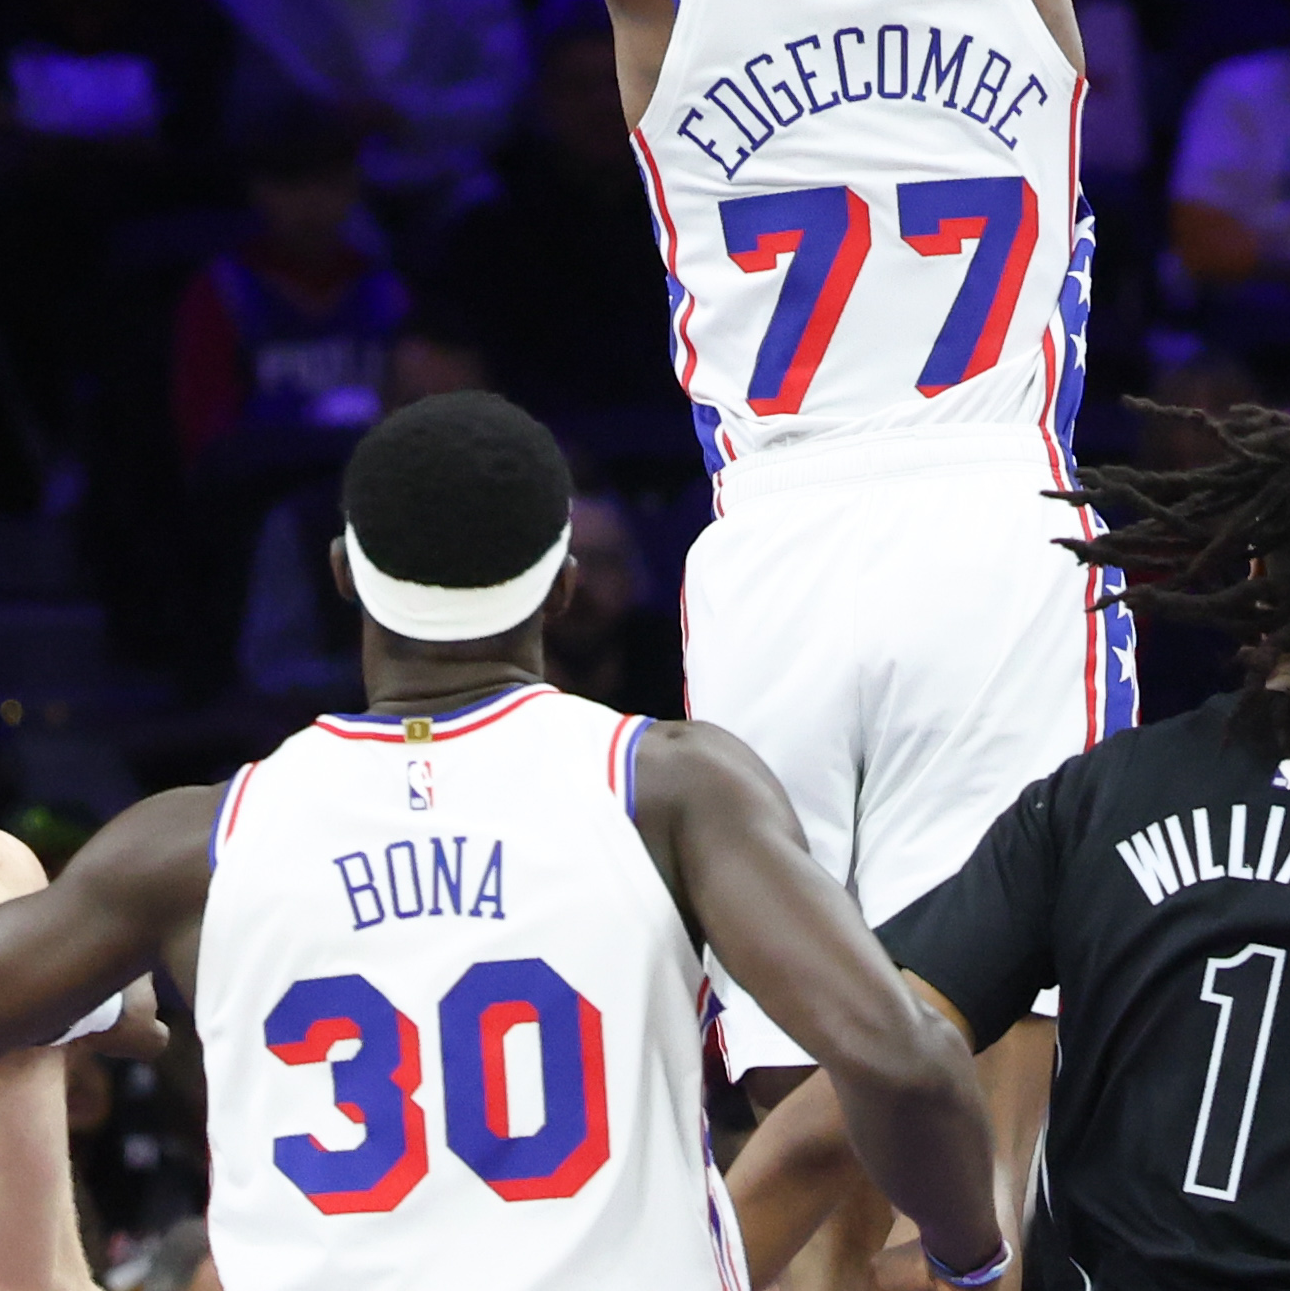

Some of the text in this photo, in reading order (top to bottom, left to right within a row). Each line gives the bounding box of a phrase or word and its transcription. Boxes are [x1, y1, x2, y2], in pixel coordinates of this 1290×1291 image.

[677, 25, 1048, 181] EDGECOMBE
[717, 176, 1039, 417] 77
[332, 836, 506, 931] BONA
[264, 957, 610, 1216] 30
[1182, 942, 1287, 1203] 1
